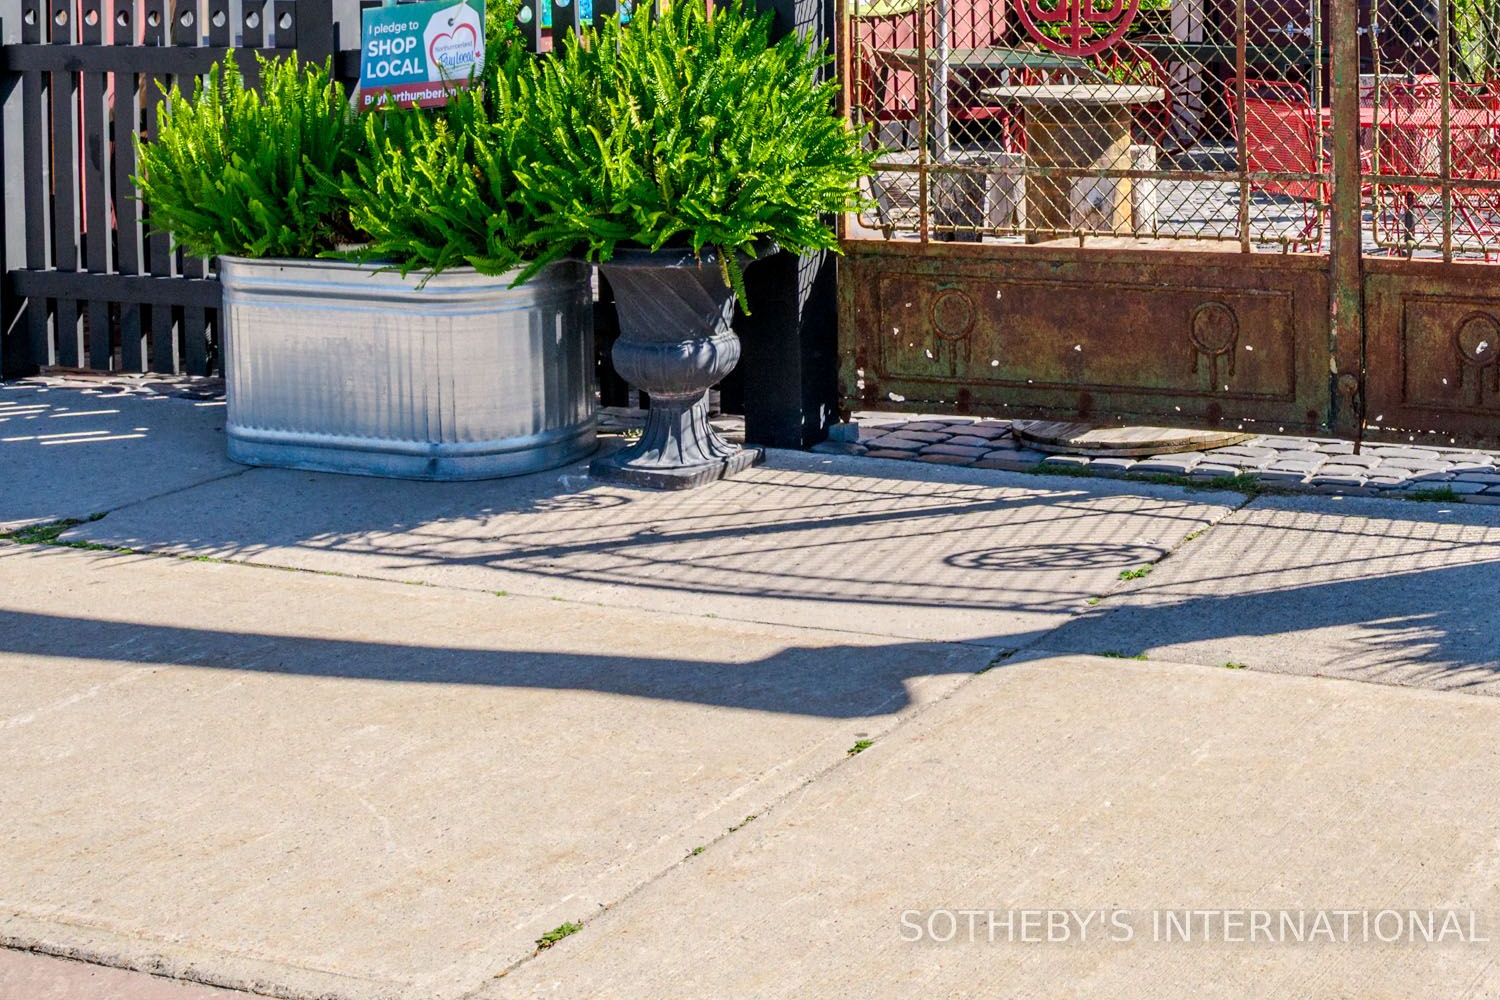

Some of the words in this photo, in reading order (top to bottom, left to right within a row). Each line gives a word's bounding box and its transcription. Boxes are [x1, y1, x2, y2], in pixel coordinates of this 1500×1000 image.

[374, 22, 406, 36] pledge
[409, 21, 419, 30] to
[368, 37, 416, 57] SHOP
[367, 58, 424, 79] LOCAL
